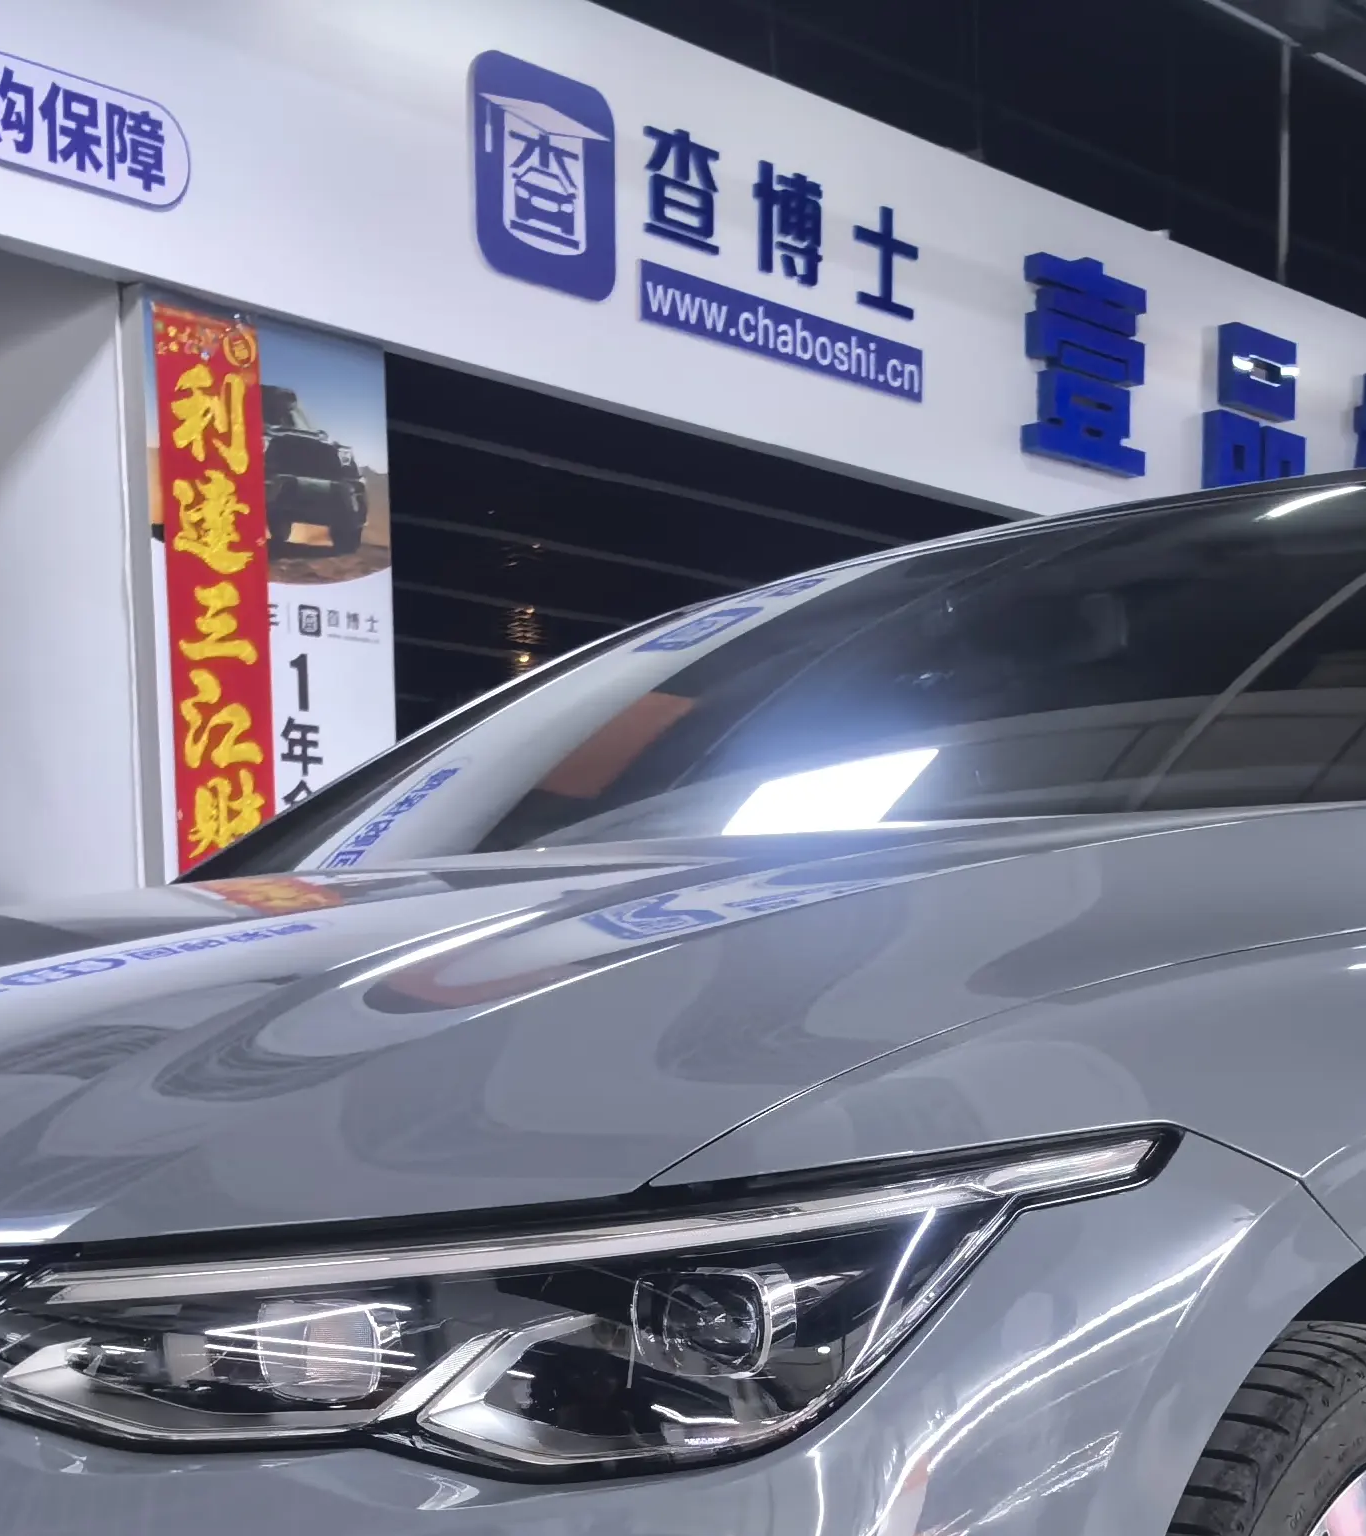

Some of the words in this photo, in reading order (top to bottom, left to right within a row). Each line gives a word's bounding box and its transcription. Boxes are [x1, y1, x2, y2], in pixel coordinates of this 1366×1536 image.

[644, 124, 919, 320] 查博士
[646, 281, 921, 394] www.chaboshi.cn
